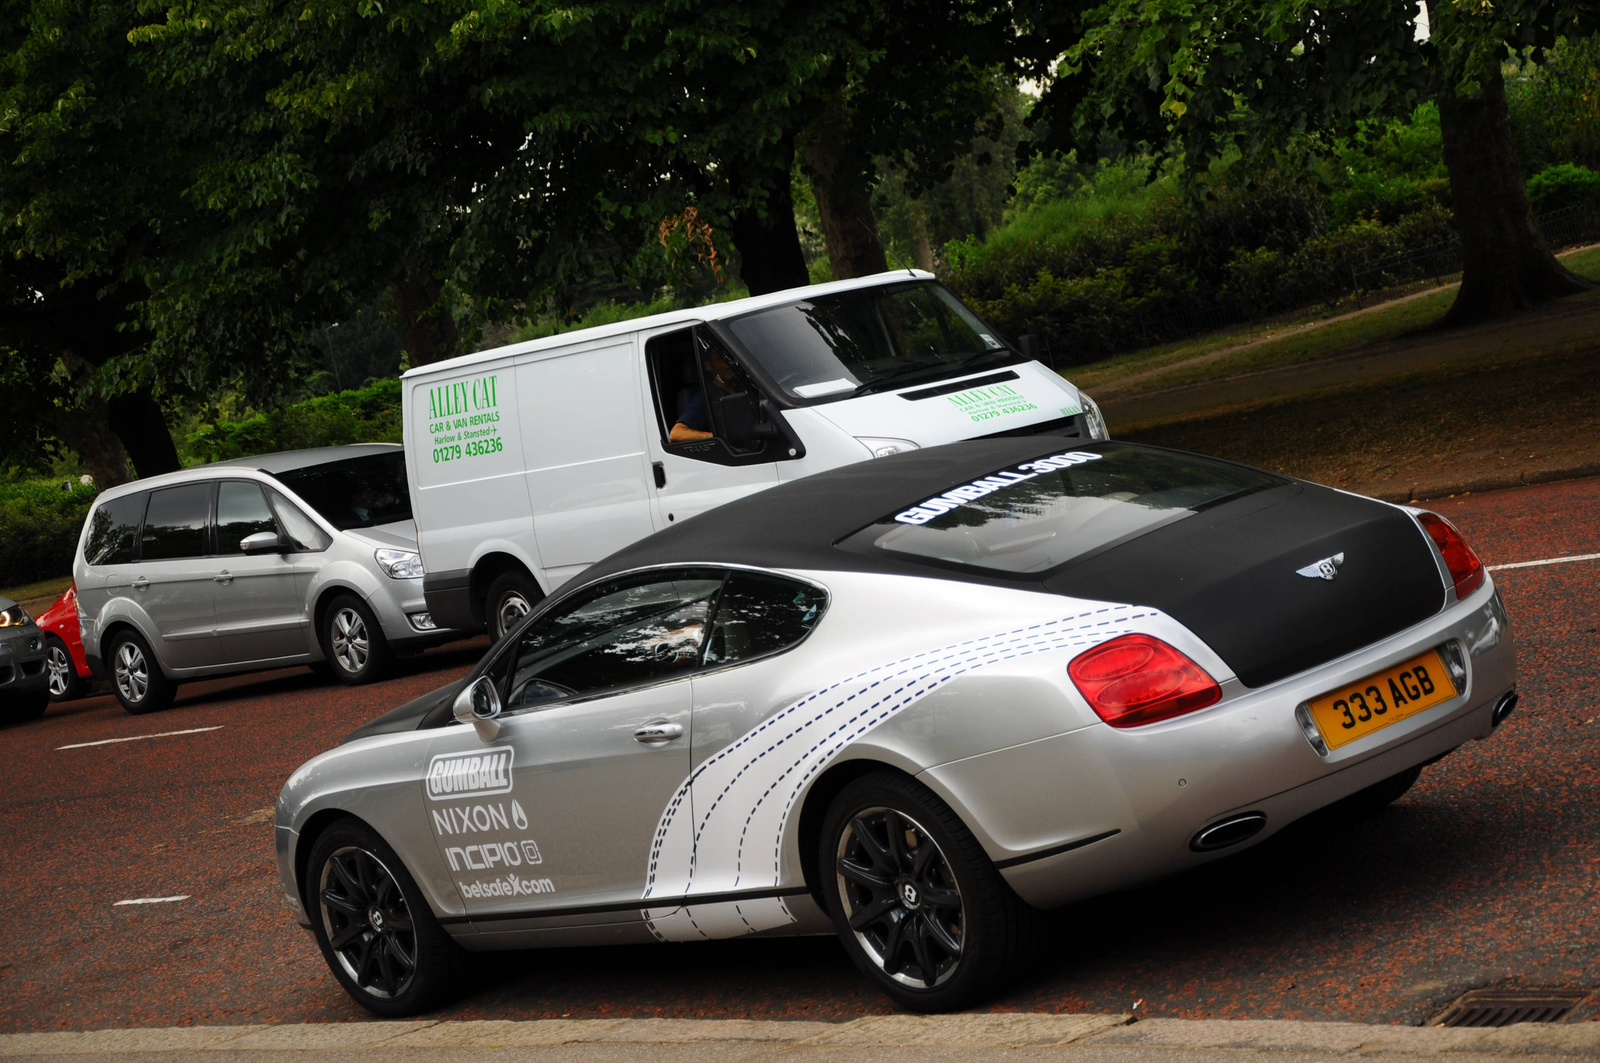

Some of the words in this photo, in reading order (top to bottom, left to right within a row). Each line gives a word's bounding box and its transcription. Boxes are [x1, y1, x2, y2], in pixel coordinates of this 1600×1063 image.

[429, 382, 468, 419] ALLEY
[473, 376, 497, 410] CAT
[947, 388, 992, 408] ALLEY
[987, 384, 1017, 397] CAT
[429, 422, 444, 434] CAR
[445, 421, 451, 431] &
[452, 417, 468, 430] VAN
[469, 411, 500, 427] RENTALS
[971, 409, 1000, 422] 01279
[1002, 402, 1038, 415] 436236
[434, 434, 456, 446] Harlow
[457, 432, 462, 441] &
[463, 425, 491, 440] Stansted
[433, 444, 462, 464] 01279
[465, 436, 503, 457] 436236
[1332, 685, 1388, 729] 333
[1387, 665, 1435, 709] AGB
[430, 753, 508, 794] GUMBALL
[432, 803, 510, 836] NIXON
